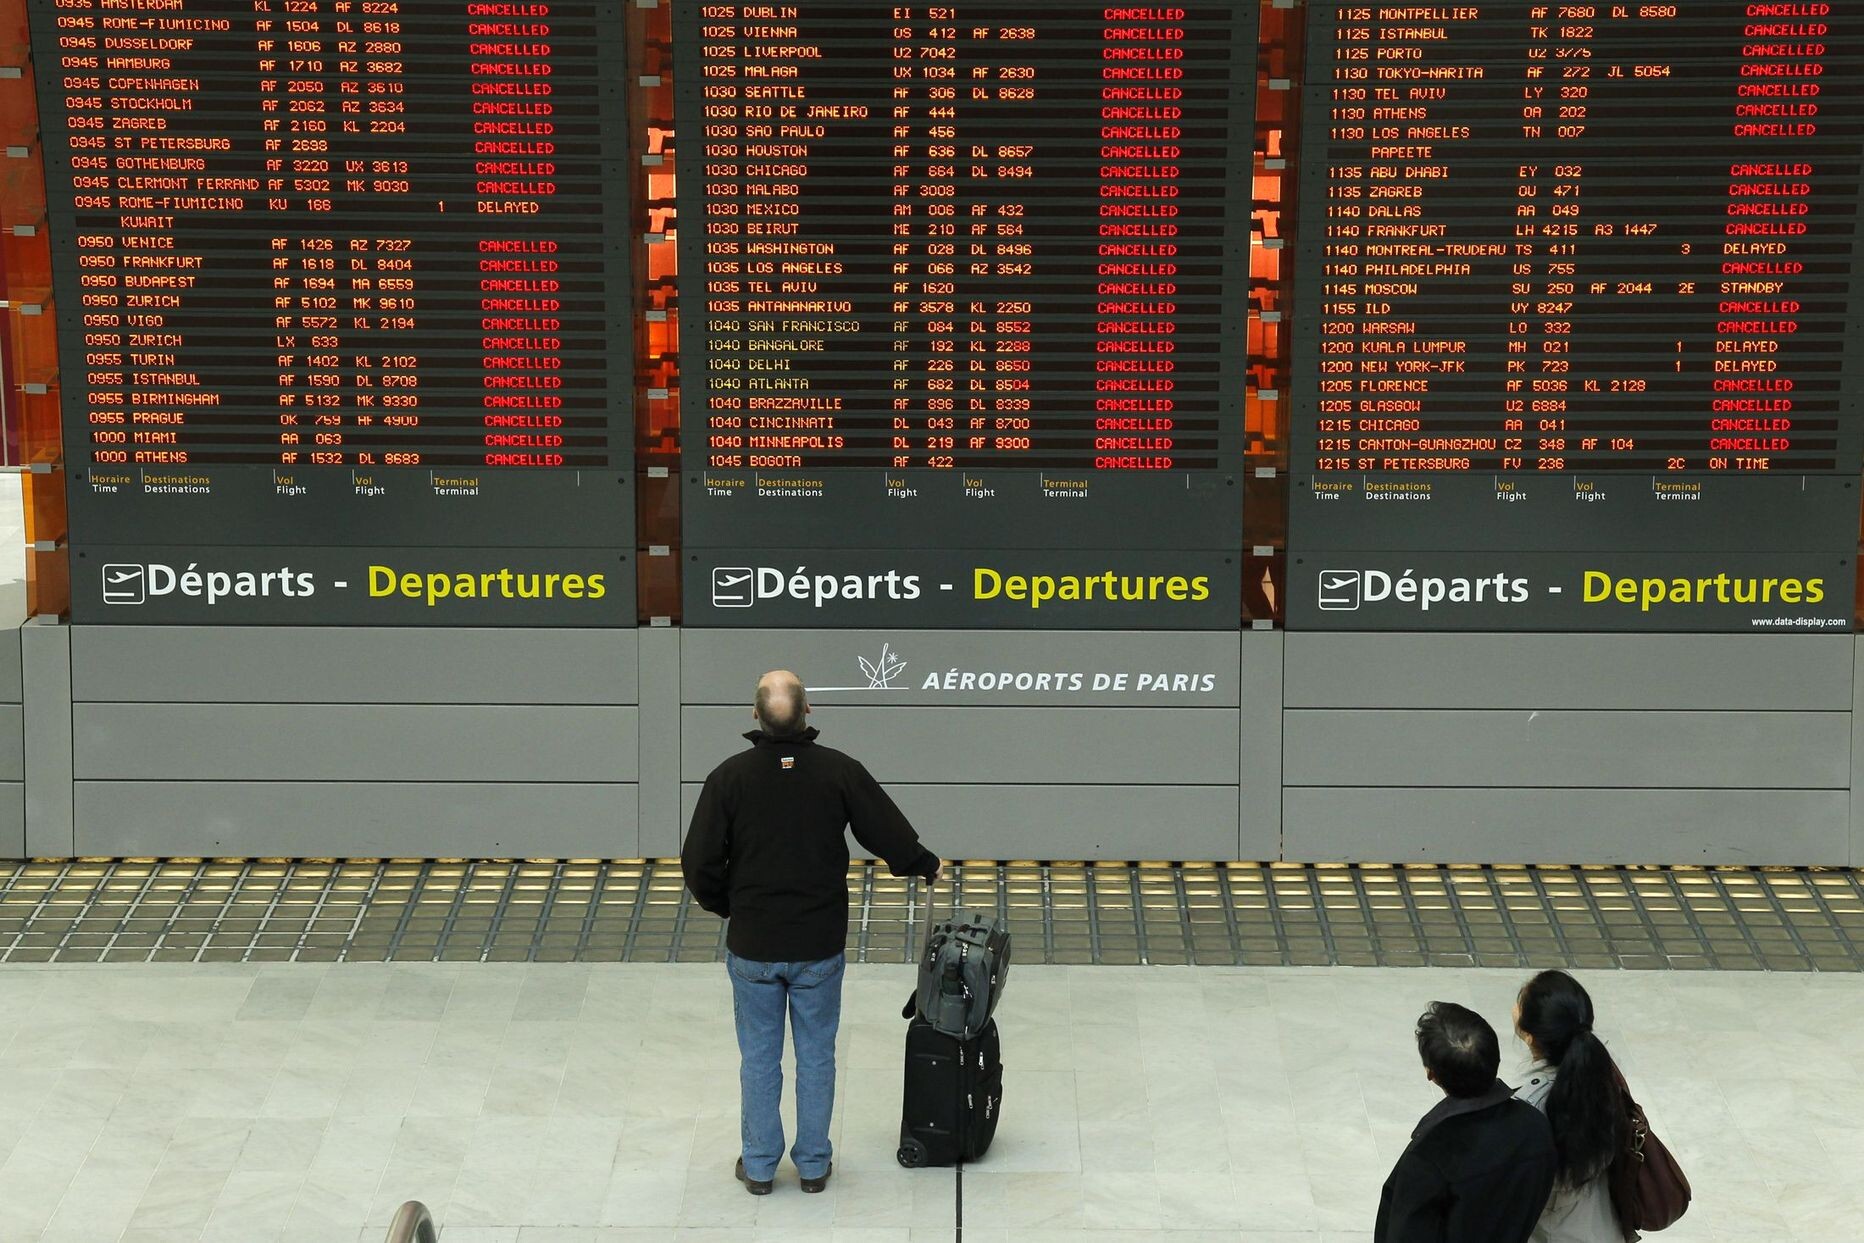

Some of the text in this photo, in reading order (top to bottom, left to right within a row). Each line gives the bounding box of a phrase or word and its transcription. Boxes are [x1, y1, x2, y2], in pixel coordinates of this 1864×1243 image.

[1339, 3, 1830, 20] 1125 MONTPELLIER AF 7680 DL 8580 CANCELLED
[58, 16, 550, 36] 0945 ROME-FIUMICINO AF 1504 DL 8618 CANCELLED
[704, 45, 1184, 60] 1025 LIVERPOOL U2 7042 CANCELLED
[1336, 63, 1824, 80] 1130 TOKYO-NARITA AF 272 JL 5054 CANCELLED
[68, 116, 554, 135] 0945 ZAGREB AF 2160 KL 2204 CANCELLED
[706, 124, 1181, 139] 1030 SAO PAULO AF 456 CANCELLED
[1372, 146, 1432, 159] PAPEETE
[706, 183, 1179, 198] 1030 MALABO AF 3008 CANCELLED
[75, 195, 539, 214] 0945 ROME-FIUMICINO KU 166 1 DELAYED
[121, 215, 174, 229] KUWAIT
[708, 281, 1176, 295] 1035 TEL AVIV AF 1620 CANCELLED
[1325, 281, 1784, 295] 1145 MOSCOW SU 250 AF 2044 2E STANDBY
[1322, 360, 1777, 373] 1200 NEW YORK-JFK PK 723 1 DELAYED
[88, 392, 562, 409] 0955 BIRMINGHAM AF 5132 MK 9330 CANCELLED
[710, 416, 1173, 431] 1040 CINCINNATI DL 043 AF 8700 CANCELLED
[95, 450, 563, 466] 1000 ATHENS AF 1532 DL 8683 CANCELLED
[711, 454, 1173, 469] 1045 BOGOTA AF 422 CANCELLED
[1319, 457, 1770, 470] 1215 ST PETERSBURG FV 236 2C ON TIME
[91, 475, 479, 487] Horaire Destinations Vol Vol Terminal
[707, 478, 1088, 488] Horaire Destinations Vol Vol Terminal
[1314, 482, 1700, 491] Horaire Destinations Vol Vol Terminal
[92, 484, 479, 497] Time Destinations Flight Flight Terminal
[707, 488, 1088, 499] Time Destinations Flight Flight Terminal
[1315, 491, 1700, 503] Time Destinations Flight Flight Terminal
[147, 563, 315, 607] Départs
[368, 565, 606, 607] Departures
[757, 565, 921, 609] Départs
[973, 567, 1210, 609] Departures
[1363, 568, 1529, 612] Départs
[1583, 570, 1825, 612] Departures
[1751, 616, 1847, 630] www.data-display.com
[921, 667, 1216, 692] AÉROPORTS DE PARIS
